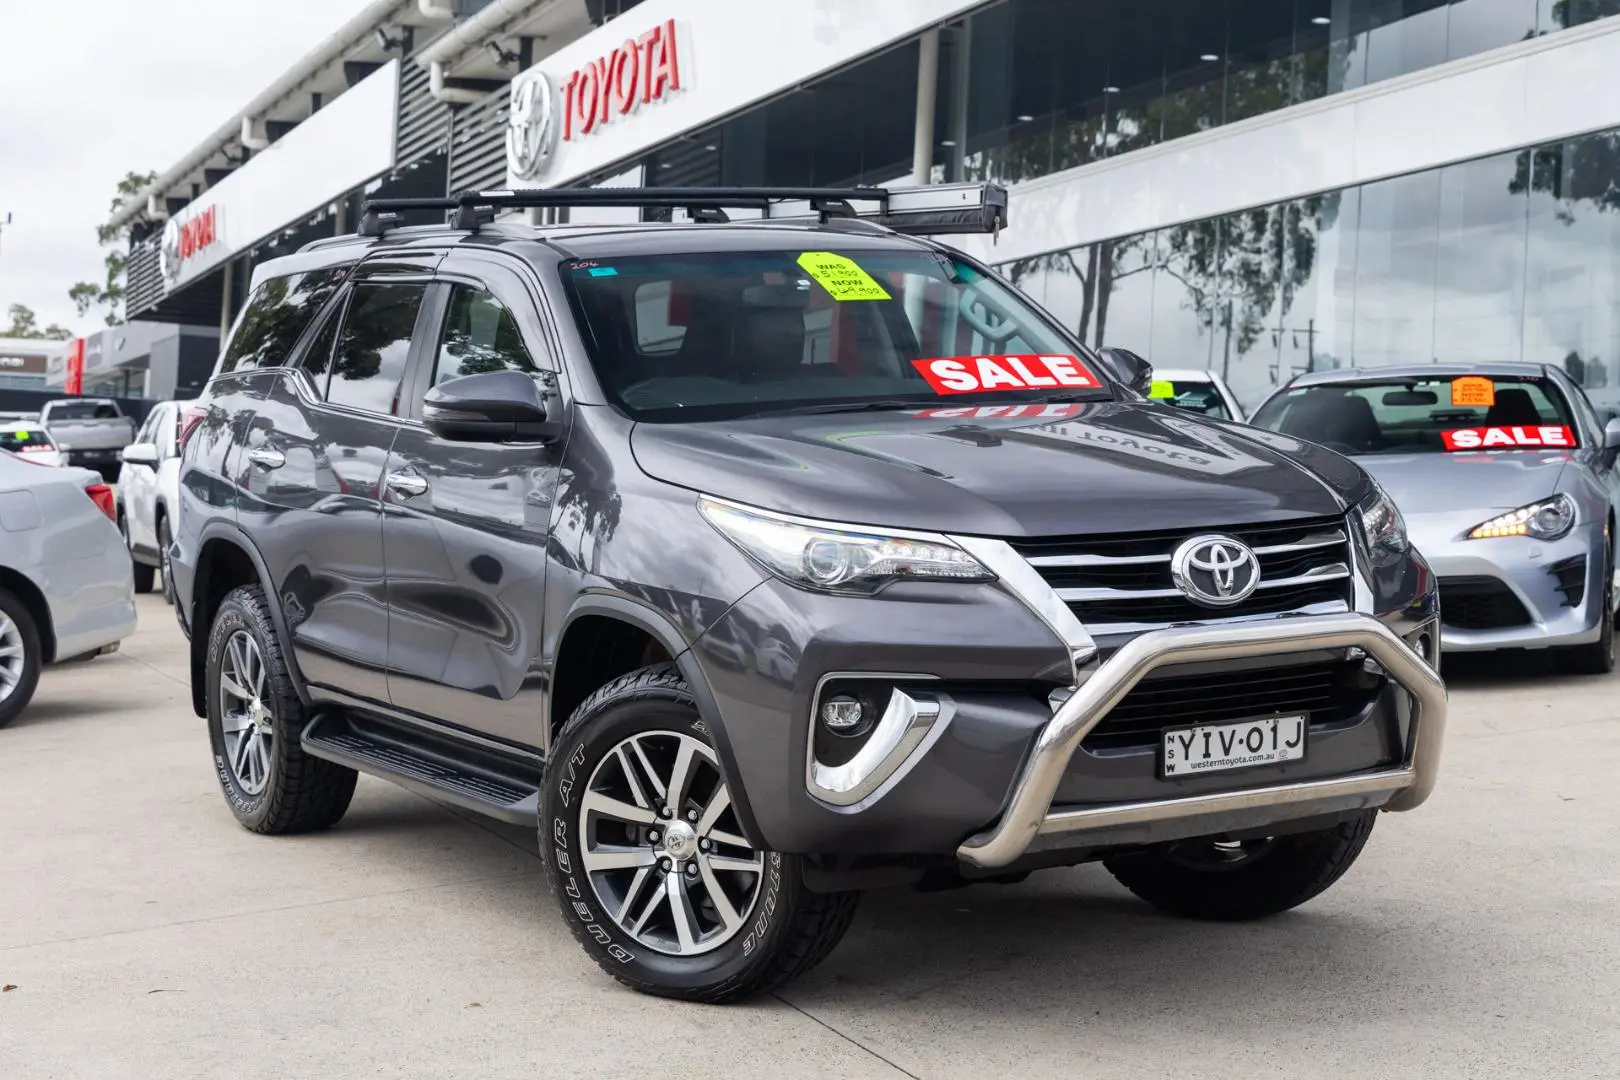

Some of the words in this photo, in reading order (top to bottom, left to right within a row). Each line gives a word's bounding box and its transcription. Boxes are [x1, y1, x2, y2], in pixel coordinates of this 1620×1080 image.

[560, 18, 680, 141] TOYOTA
[929, 356, 1090, 391] SALE
[1451, 426, 1568, 448] SALE
[559, 743, 585, 808] A/T
[1190, 753, 1275, 770] westerntoyota.com.au
[554, 818, 635, 963] DUELER
